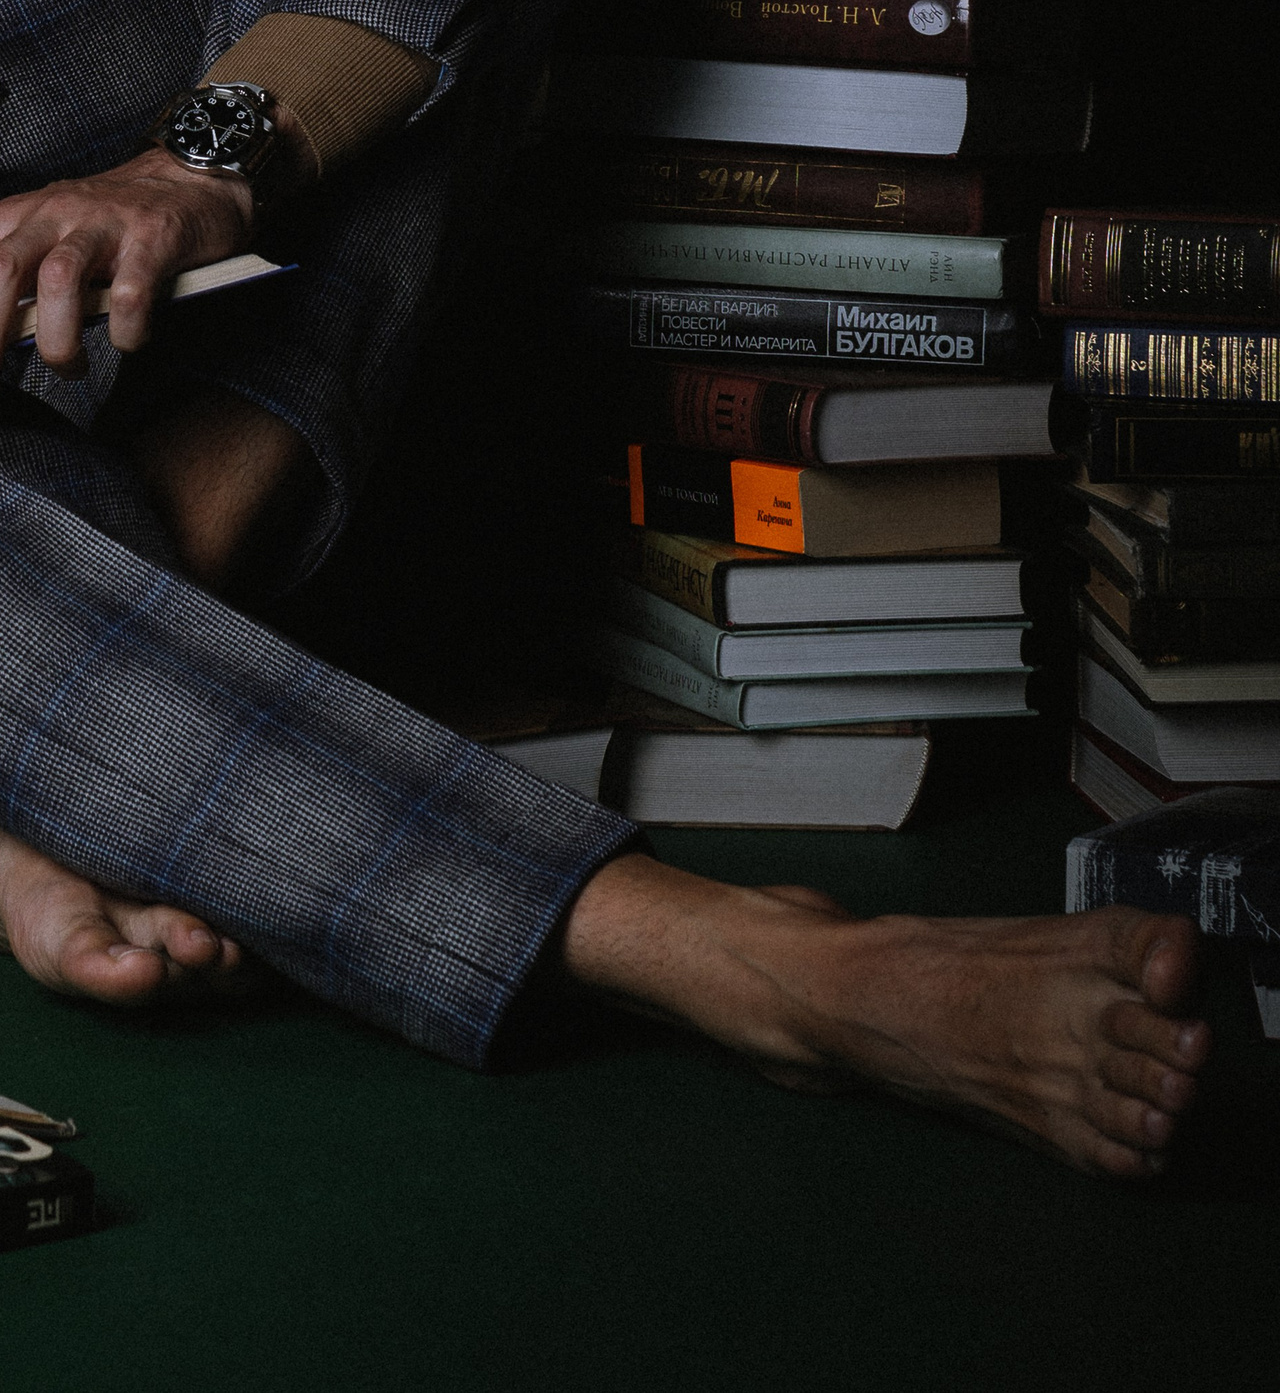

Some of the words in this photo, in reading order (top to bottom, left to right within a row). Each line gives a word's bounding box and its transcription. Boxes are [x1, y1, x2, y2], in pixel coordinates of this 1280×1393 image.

[761, 2, 833, 24] Толстой
[837, 6, 859, 25] Н.
[864, 6, 887, 26] Л.
[643, 242, 708, 261] ПЛЕЧИ
[713, 247, 829, 268] РАСПРАВИЛ
[835, 254, 911, 273] АТЛАНТ
[943, 254, 953, 282] АЙН
[660, 299, 711, 315] БЕЛАЯ
[660, 315, 726, 332] ПОВЕСТИ
[836, 305, 938, 333] Михаил
[660, 332, 718, 347] МАСТЕР
[720, 335, 732, 348] И
[734, 335, 817, 353] МАРГАРИТА
[835, 331, 975, 360] БУЛГАКОВ
[675, 485, 720, 505] ТОЛСТОЙ
[773, 495, 791, 510] Анна
[756, 509, 793, 528] Каренина
